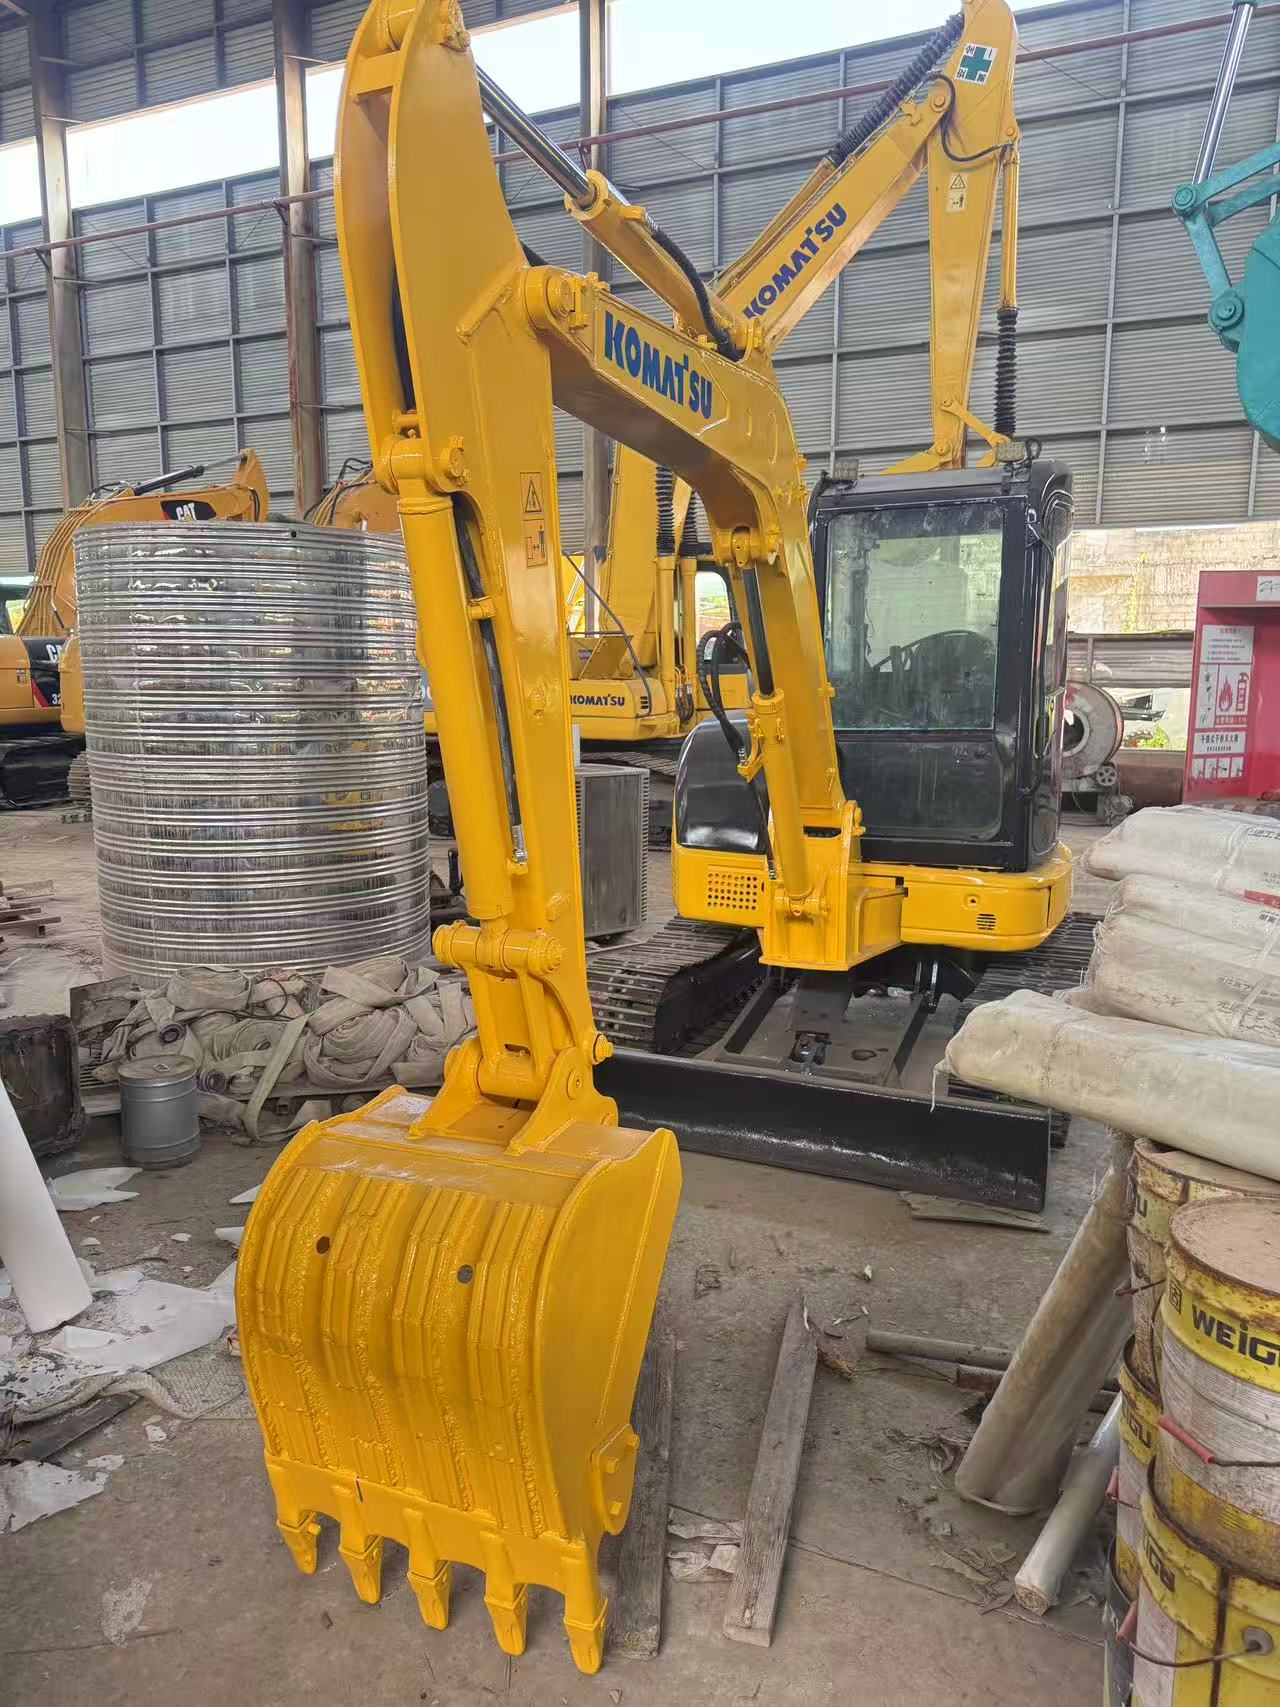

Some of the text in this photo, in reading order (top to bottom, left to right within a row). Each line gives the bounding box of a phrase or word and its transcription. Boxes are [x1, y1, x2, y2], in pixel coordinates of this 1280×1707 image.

[742, 202, 848, 319] KOMATSU
[604, 310, 713, 419] KOMATSU
[176, 502, 197, 520] CAT
[570, 694, 625, 706] KOMATSU
